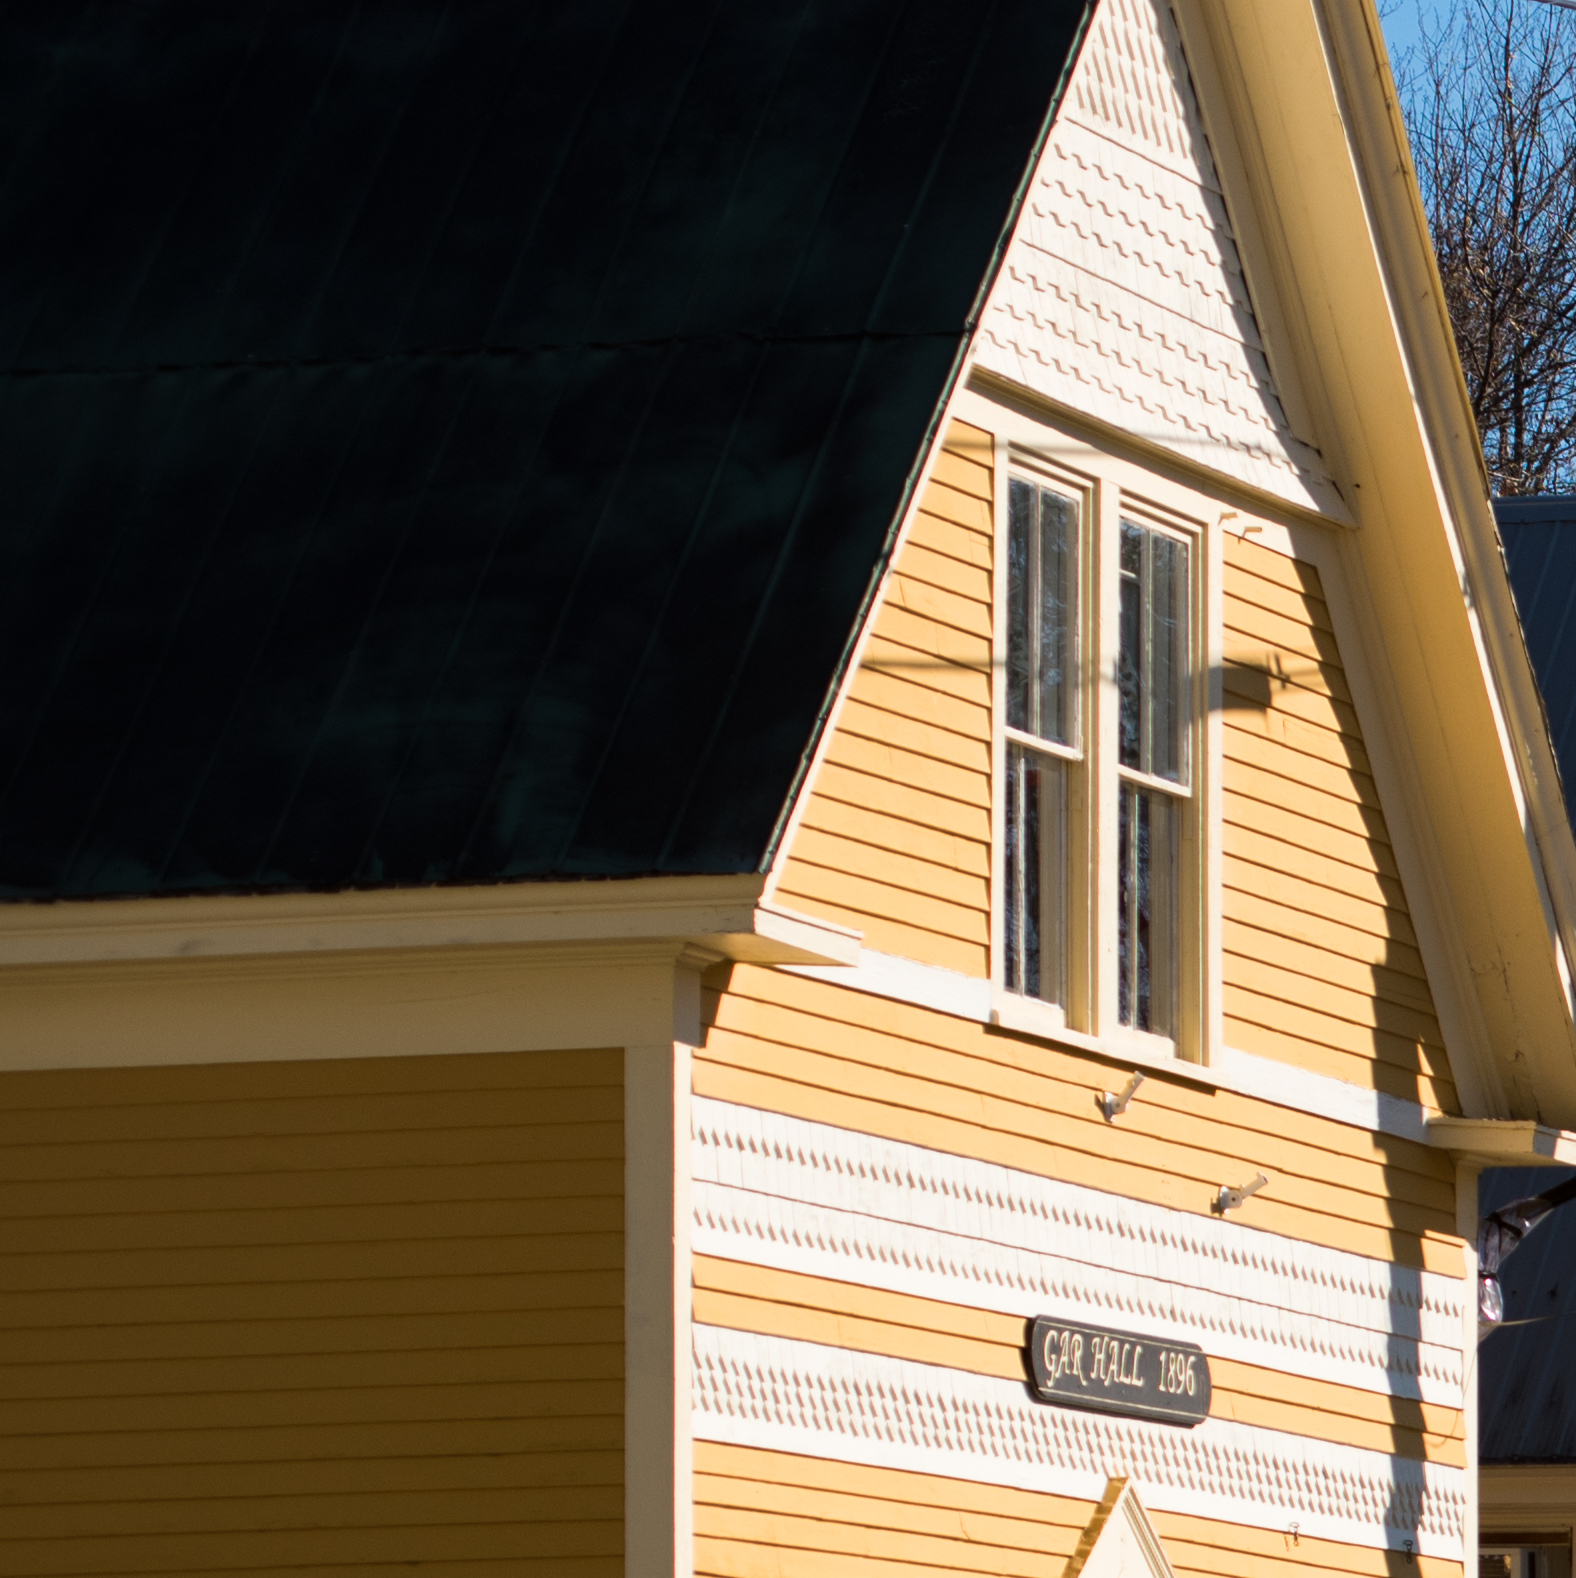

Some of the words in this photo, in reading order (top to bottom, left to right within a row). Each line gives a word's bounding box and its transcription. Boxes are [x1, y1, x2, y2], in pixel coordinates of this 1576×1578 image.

[1044, 1330, 1088, 1387] GAR
[1090, 1336, 1144, 1387] HALL
[1158, 1351, 1196, 1397] 1896
